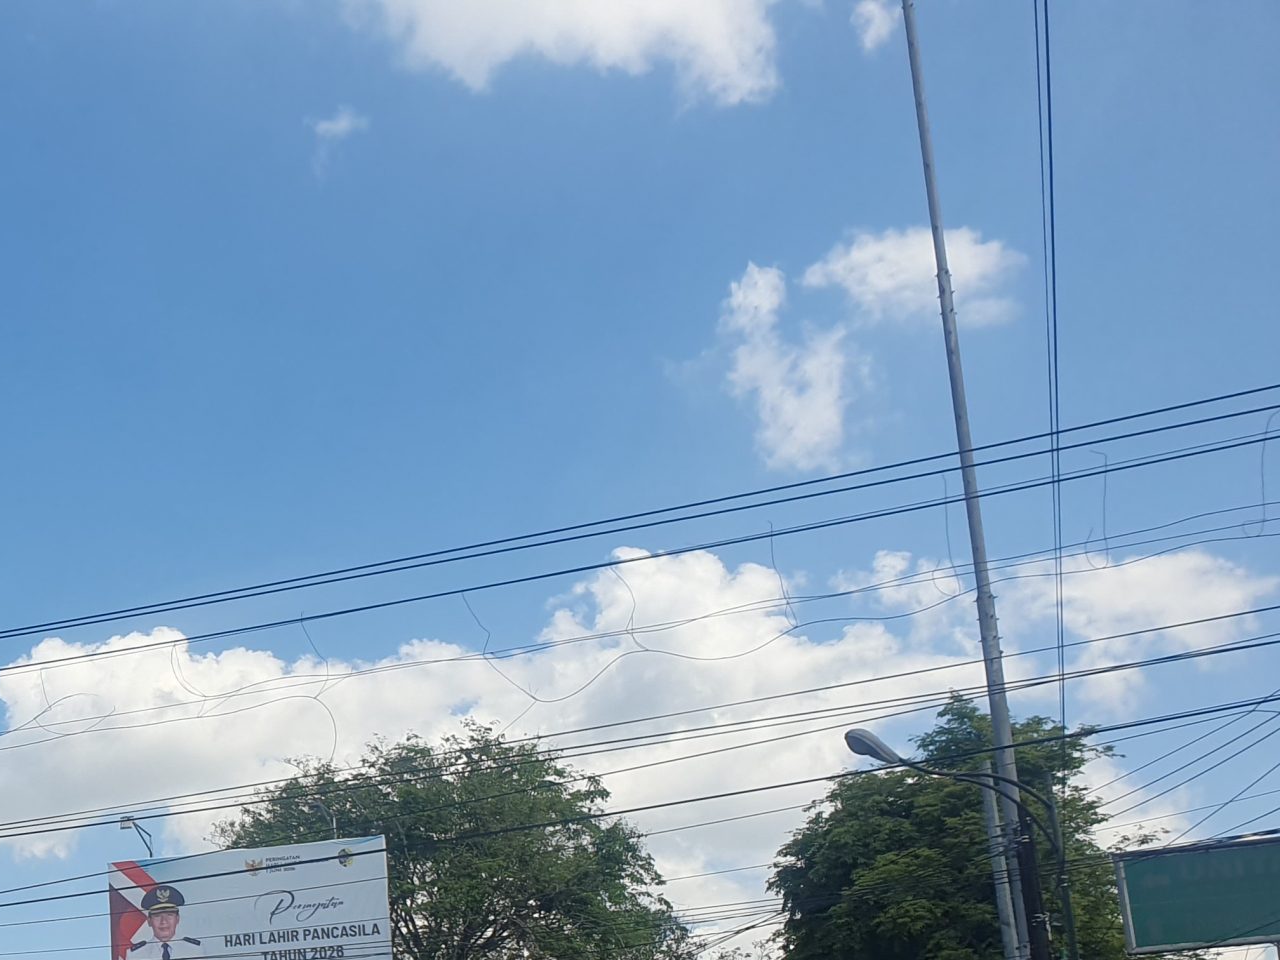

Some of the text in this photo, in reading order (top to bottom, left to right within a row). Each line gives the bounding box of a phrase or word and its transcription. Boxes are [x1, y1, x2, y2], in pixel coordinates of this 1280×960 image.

[224, 923, 381, 948] HARI LAHIR PANCASILA
[310, 946, 345, 960] 2026
